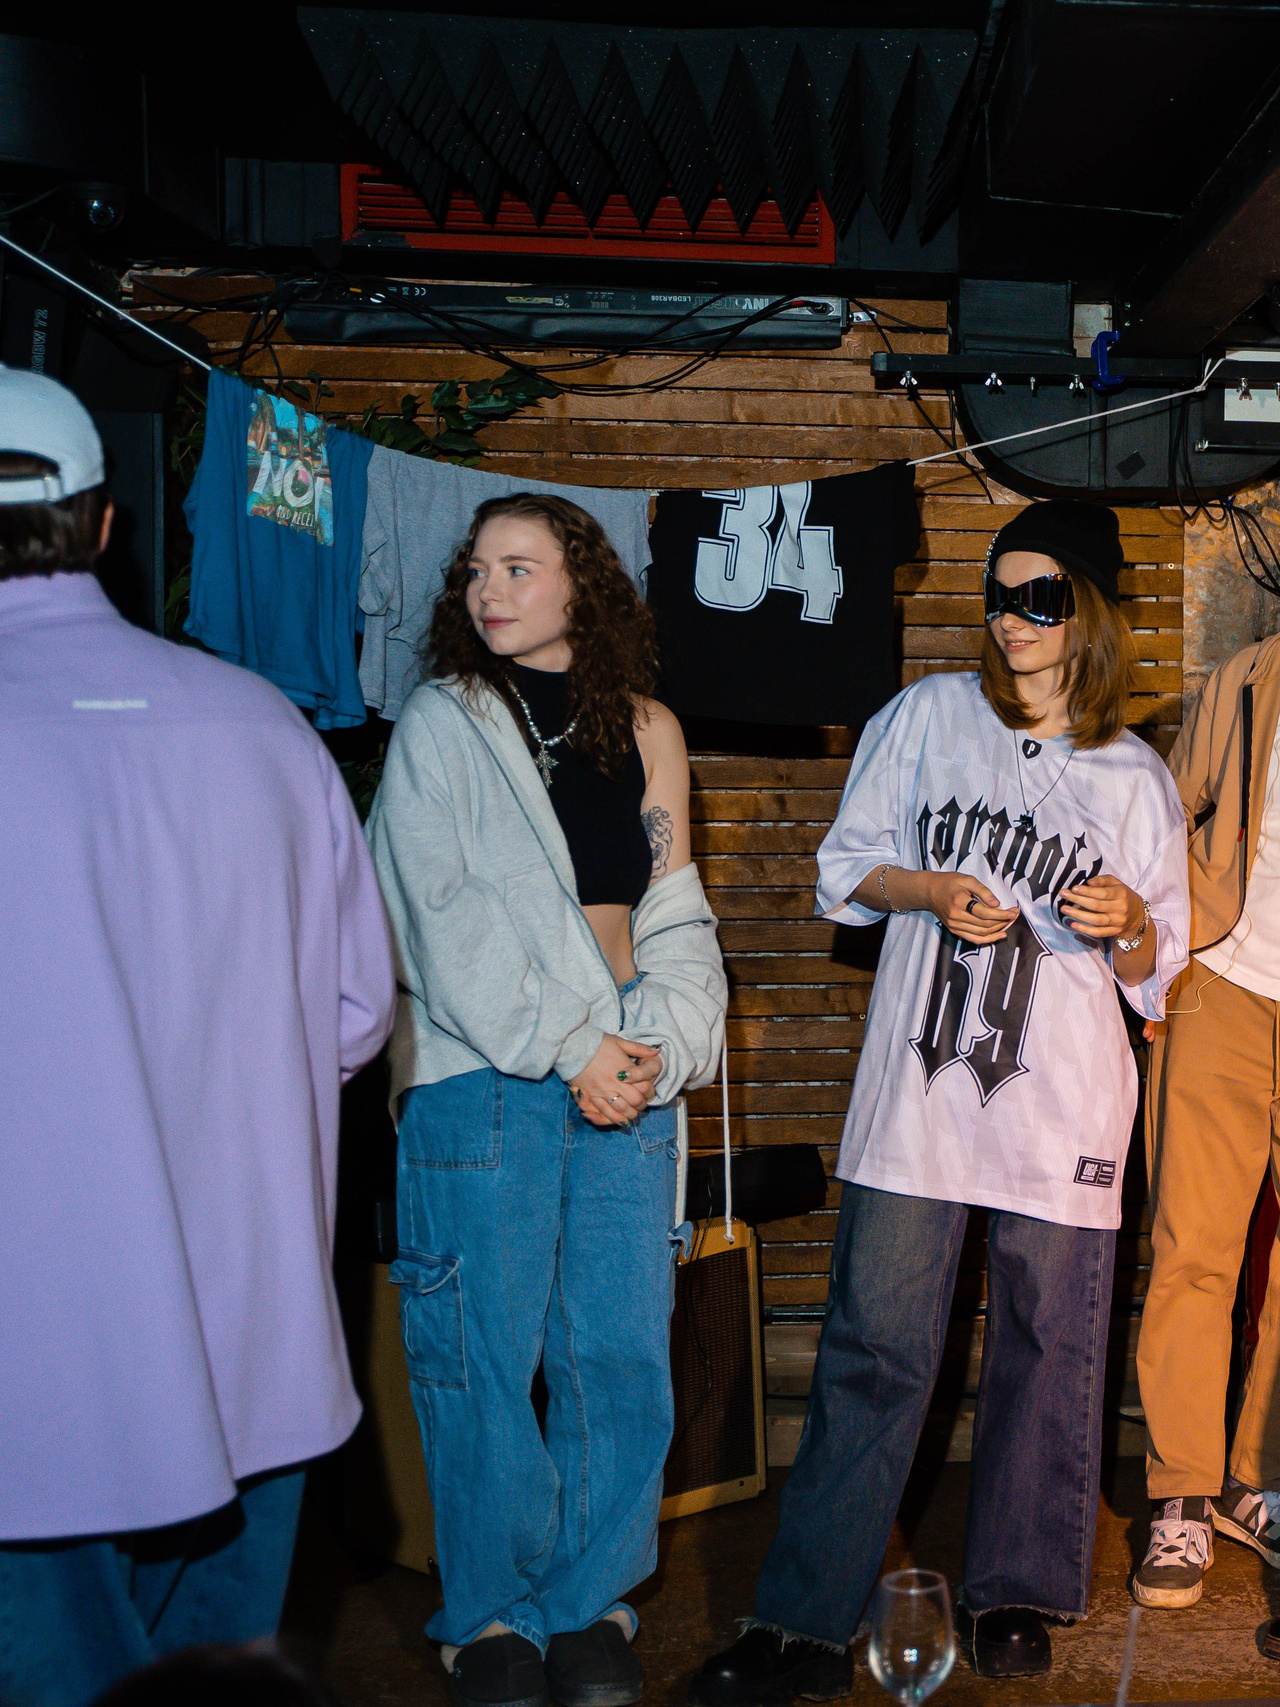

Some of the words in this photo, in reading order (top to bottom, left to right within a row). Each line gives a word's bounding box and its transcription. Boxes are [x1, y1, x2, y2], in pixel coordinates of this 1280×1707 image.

[33, 308, 49, 329] 72
[30, 330, 48, 375] RGBW
[694, 480, 844, 624] 34
